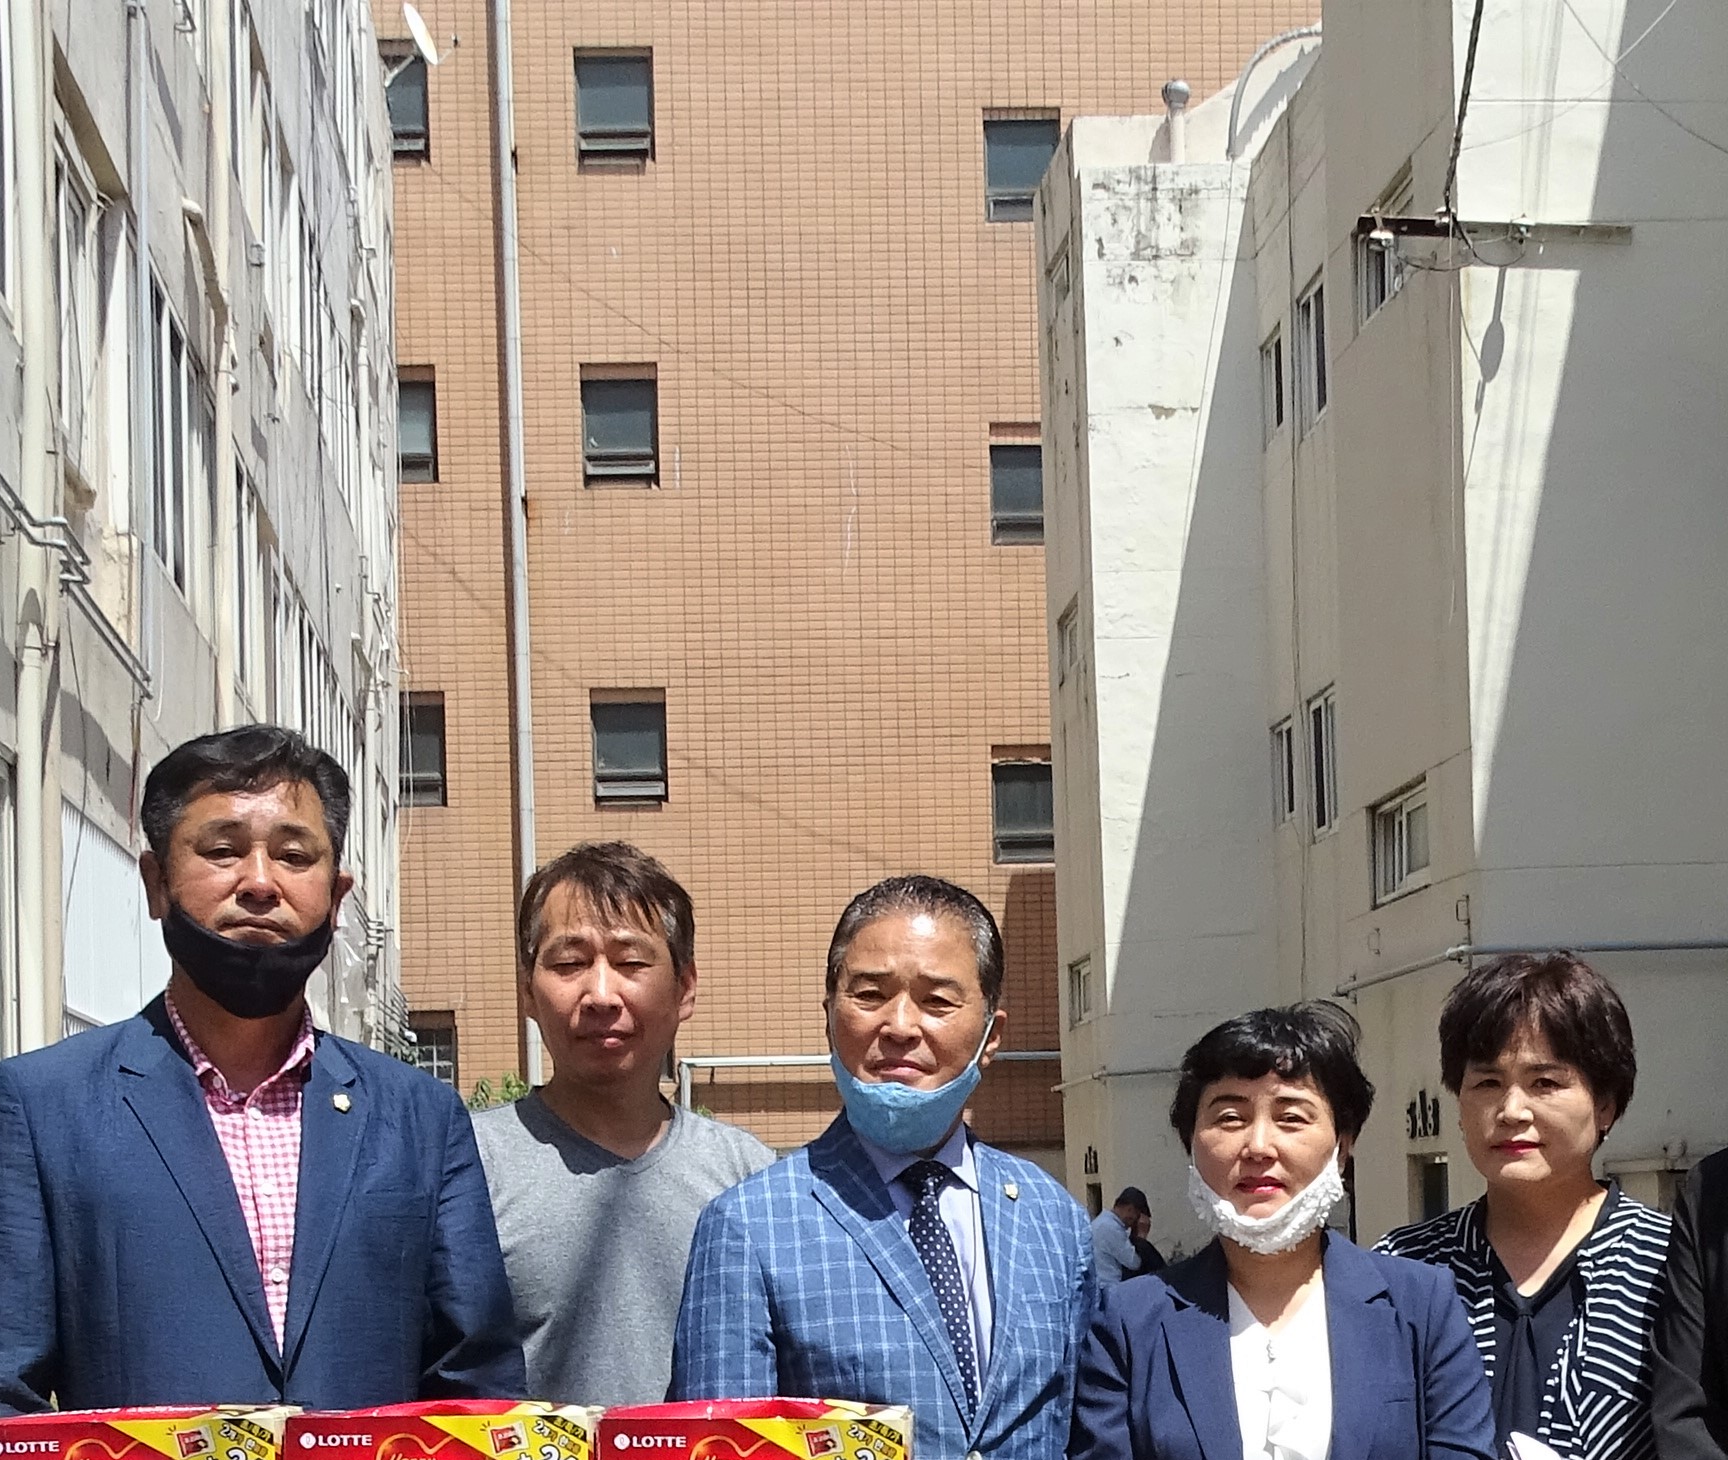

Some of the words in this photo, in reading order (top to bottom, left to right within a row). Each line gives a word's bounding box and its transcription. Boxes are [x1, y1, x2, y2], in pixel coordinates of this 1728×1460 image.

[318, 1435, 372, 1446] LOTTE
[632, 1436, 686, 1447] LOTTE
[6, 1441, 59, 1453] LOTTE
